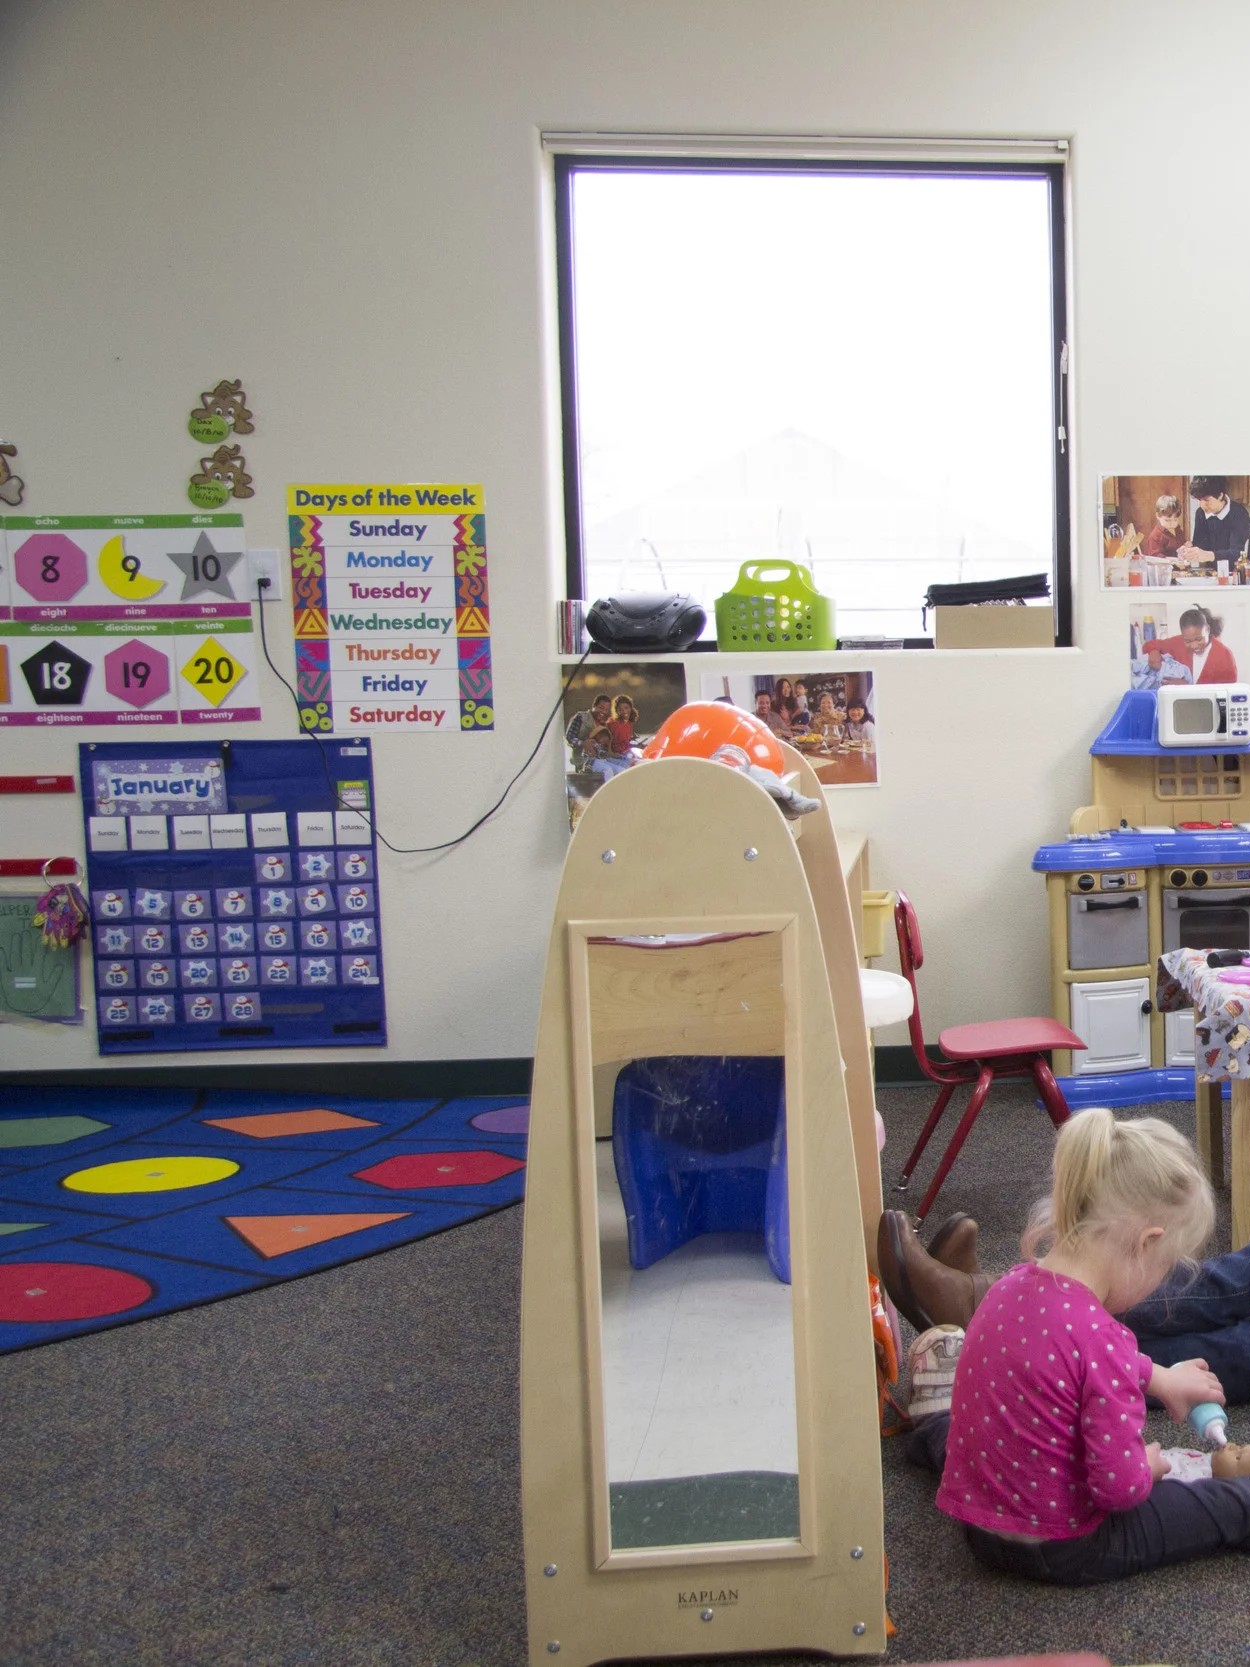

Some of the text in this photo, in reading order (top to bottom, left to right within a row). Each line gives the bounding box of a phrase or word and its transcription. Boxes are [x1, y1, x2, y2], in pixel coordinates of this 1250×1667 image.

[295, 488, 477, 511] Days of the Week
[35, 516, 213, 525] ocho nueve diez
[349, 519, 428, 541] Sunday
[41, 554, 222, 583] 8 9 10
[346, 550, 434, 572] Monday
[348, 581, 433, 603] Tuesday
[40, 606, 217, 617] eight nine ten
[105, 624, 158, 632] diecinueve
[194, 622, 224, 630] veinte
[329, 612, 454, 634] Wednesday
[345, 643, 441, 665] Thursday
[41, 656, 234, 690] 18 19 20
[362, 674, 428, 696] Friday
[36, 711, 234, 724] eighteen nineteen twenty
[349, 704, 446, 727] Saturday
[110, 778, 211, 798] January
[271, 861, 360, 877] 1 2 3
[107, 897, 363, 913] 4 5 6 7 8 9 10
[110, 928, 364, 948] 11 12 13 14 15 16 17
[110, 966, 368, 984] 18 19 20 21 22 23 24
[110, 1005, 251, 1019] 25 26 27 28
[678, 1589, 739, 1603] KAPLAN
